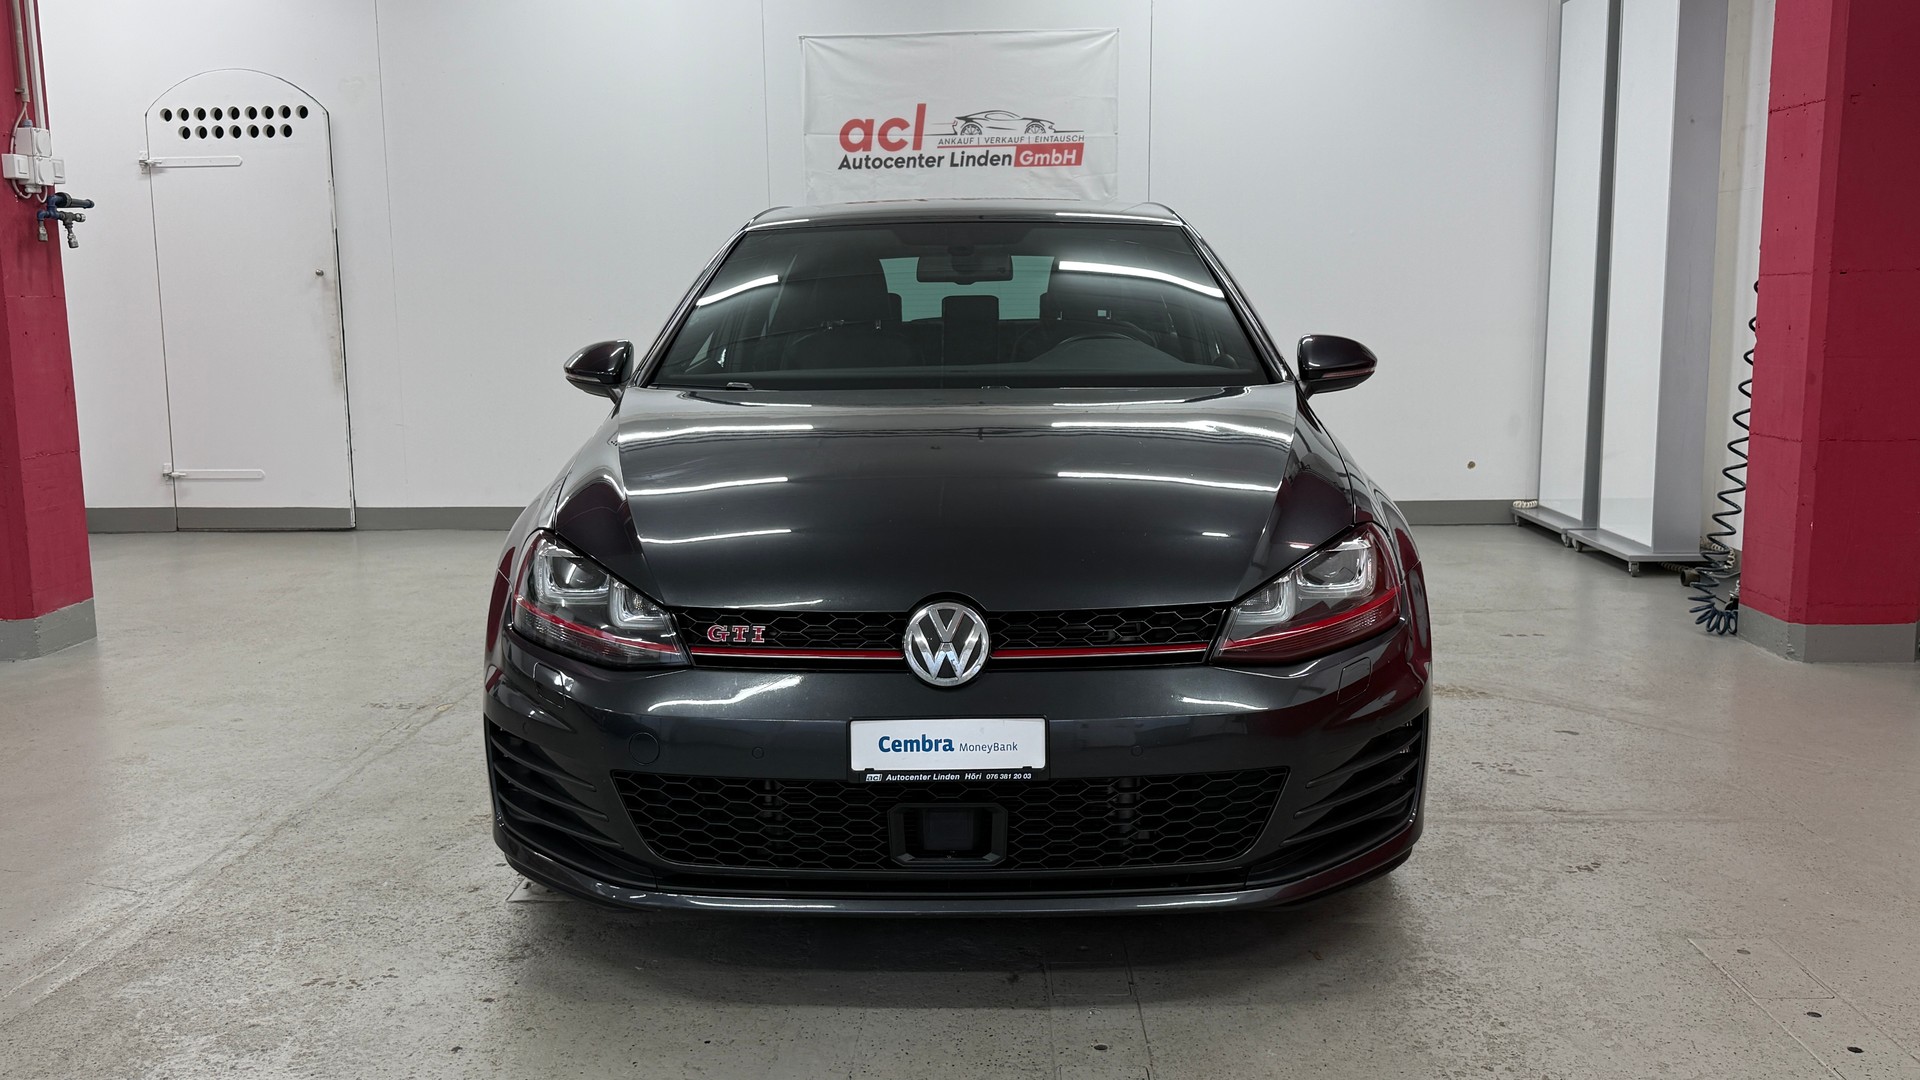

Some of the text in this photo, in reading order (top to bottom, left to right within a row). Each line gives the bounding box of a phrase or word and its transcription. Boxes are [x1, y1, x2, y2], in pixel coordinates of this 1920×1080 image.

[839, 103, 926, 152] acl
[938, 135, 1085, 145] ANKAUF VERKAUF EINTAUSCH
[838, 149, 1077, 170] Autocenter Linden GmbH
[707, 624, 766, 643] GTI
[878, 734, 1018, 754] Cembra MoneyBank
[933, 773, 960, 781] Linden
[964, 772, 982, 780] Höri
